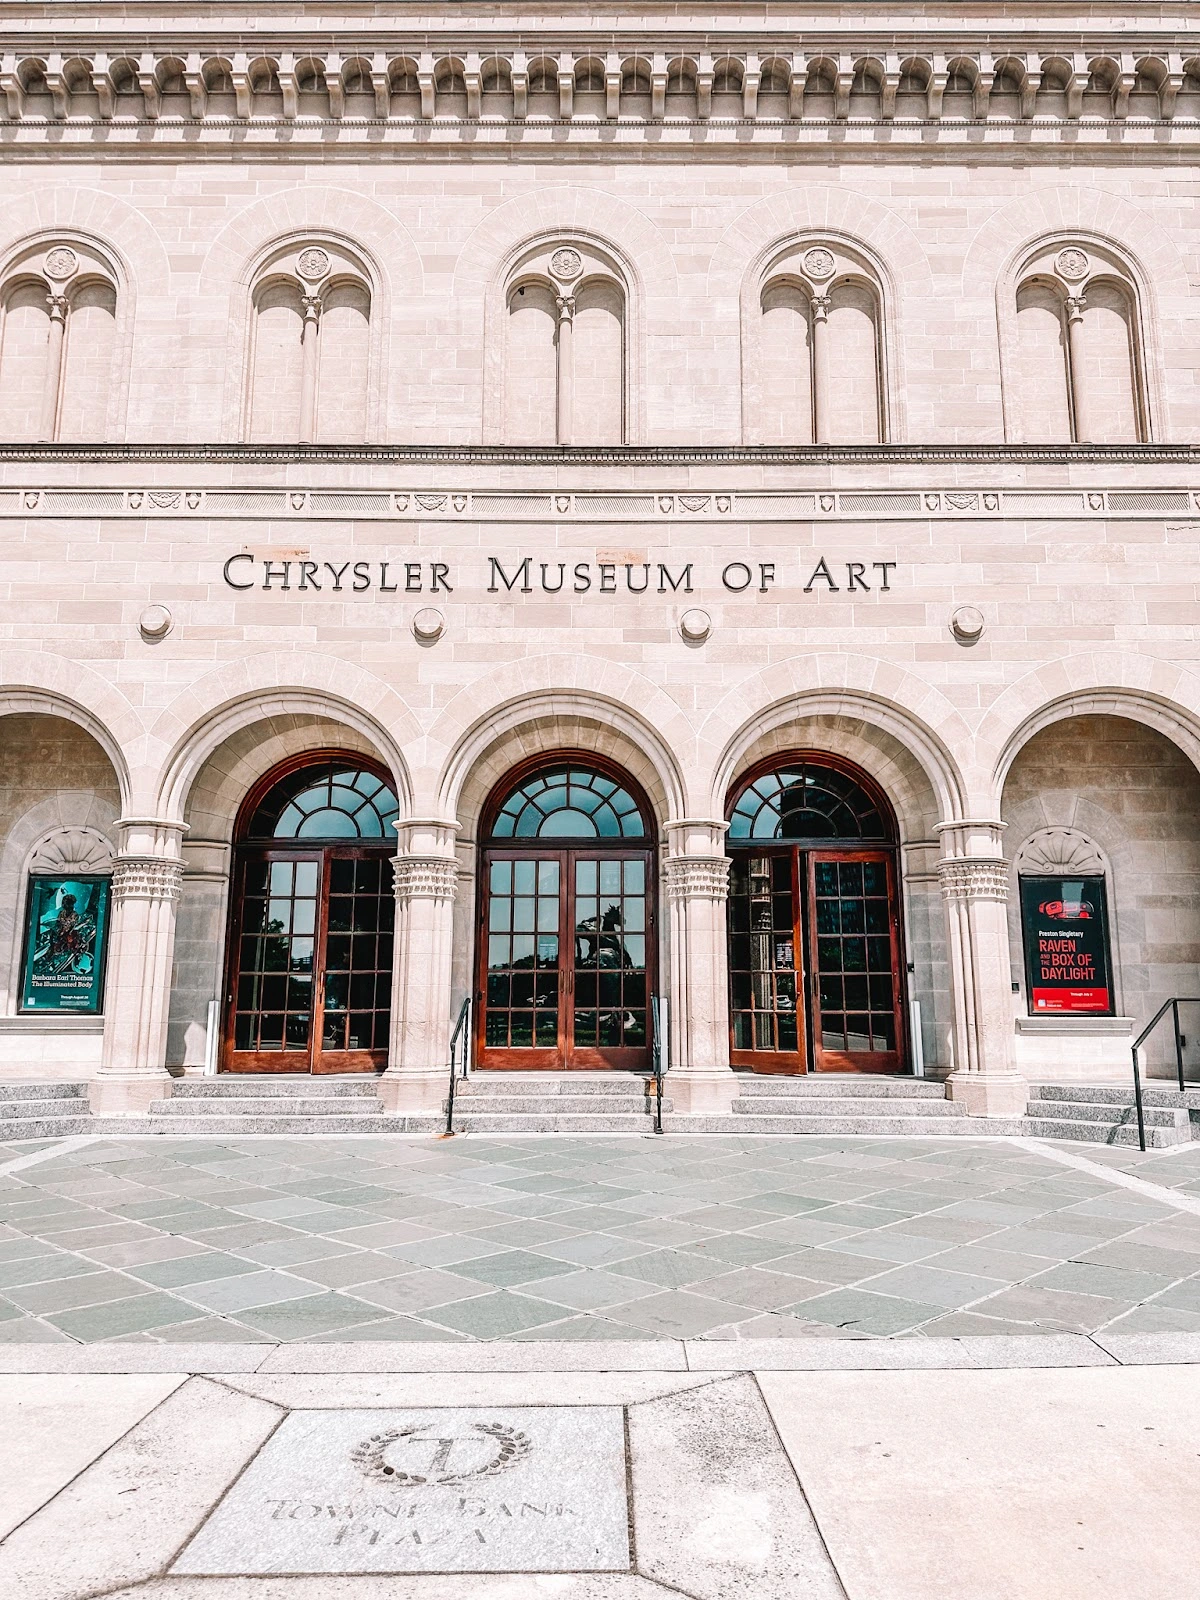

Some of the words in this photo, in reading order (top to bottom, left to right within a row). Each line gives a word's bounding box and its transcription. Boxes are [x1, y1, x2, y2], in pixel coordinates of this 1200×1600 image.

[223, 553, 453, 593] CHRYSLER
[487, 556, 694, 594] MUSEUM
[722, 562, 775, 593] OF
[803, 555, 897, 593] ART
[1059, 930, 1084, 938] Singletary
[1039, 939, 1076, 952] RAVEN
[1051, 953, 1075, 966] BOX
[1077, 953, 1092, 966] OF
[1041, 967, 1096, 980] DAYLIGHT
